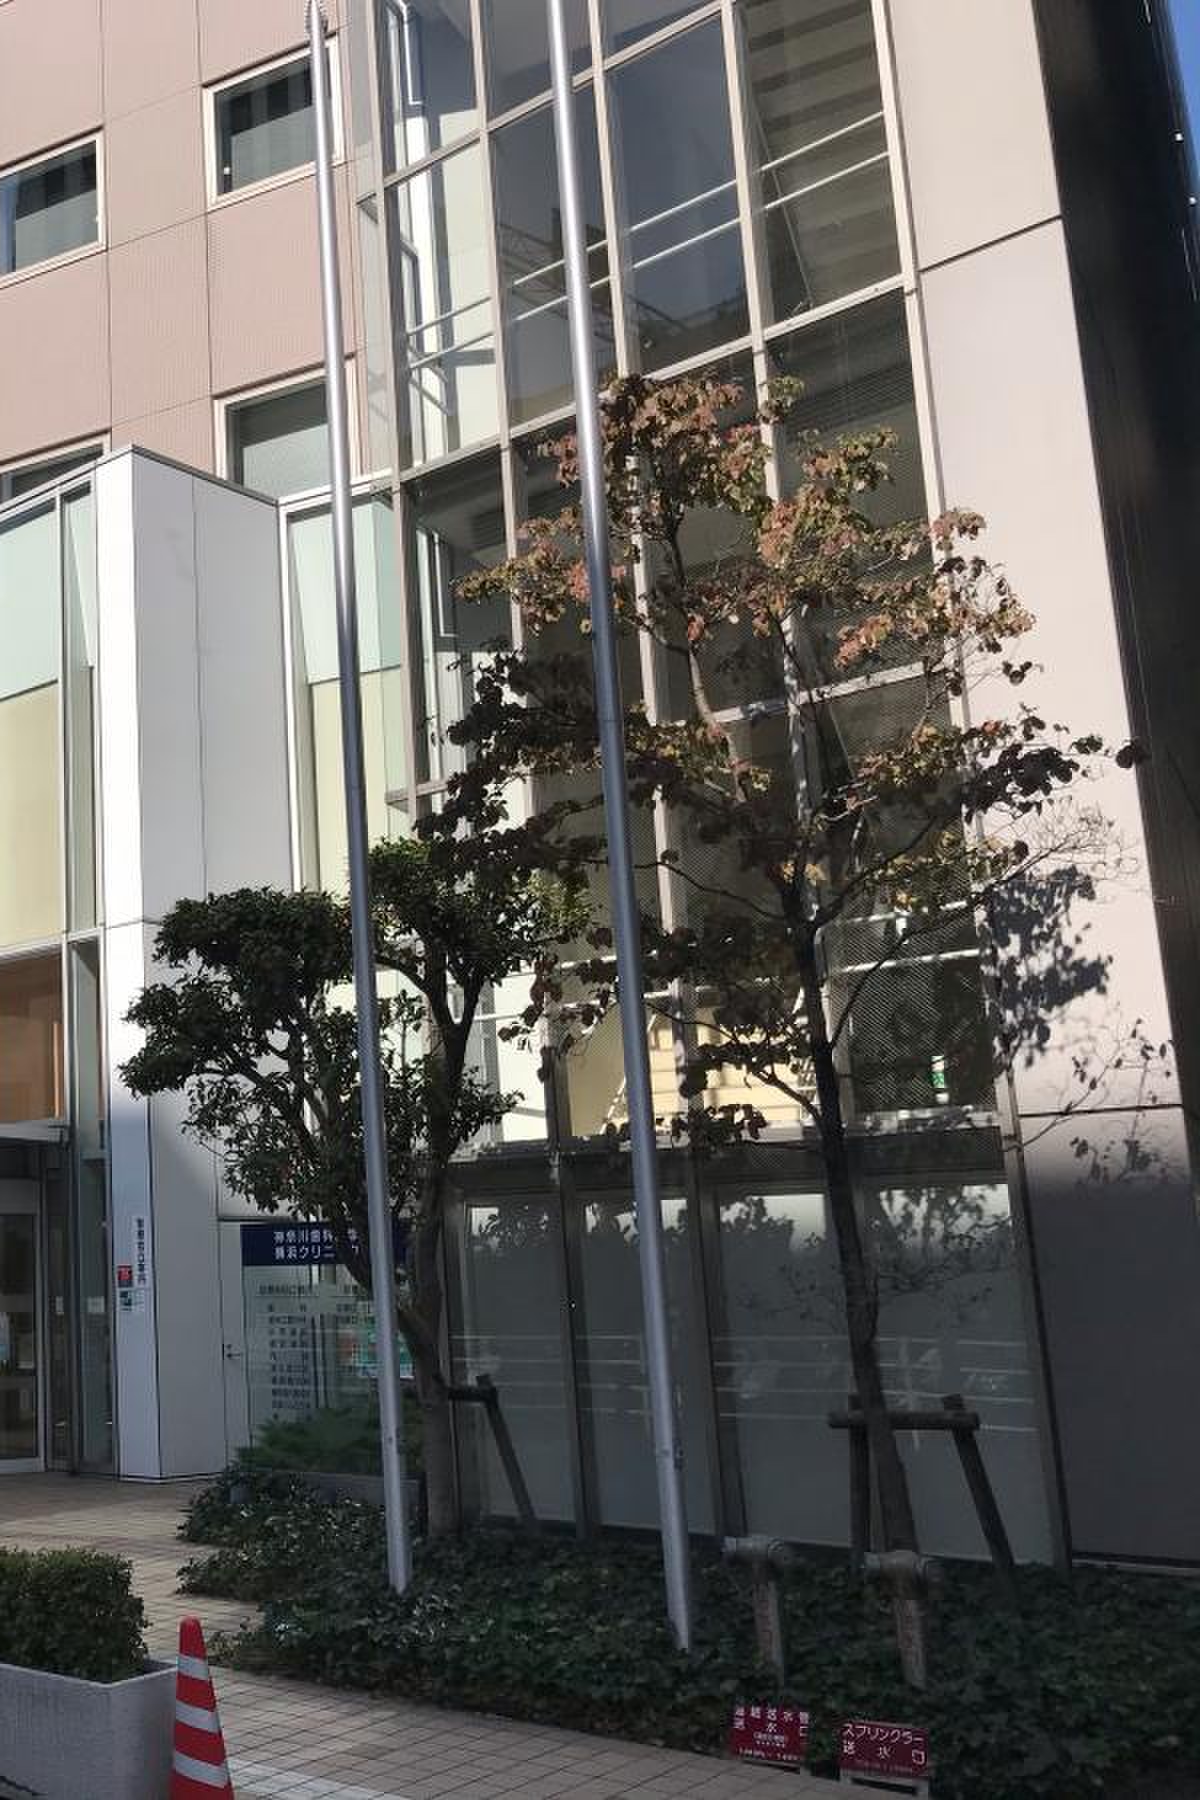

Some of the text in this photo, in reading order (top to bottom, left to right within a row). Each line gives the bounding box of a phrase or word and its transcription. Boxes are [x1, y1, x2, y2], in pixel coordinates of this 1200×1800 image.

[842, 1722, 925, 1745] スプリンクラー
[842, 1739, 926, 1765] 送水口
